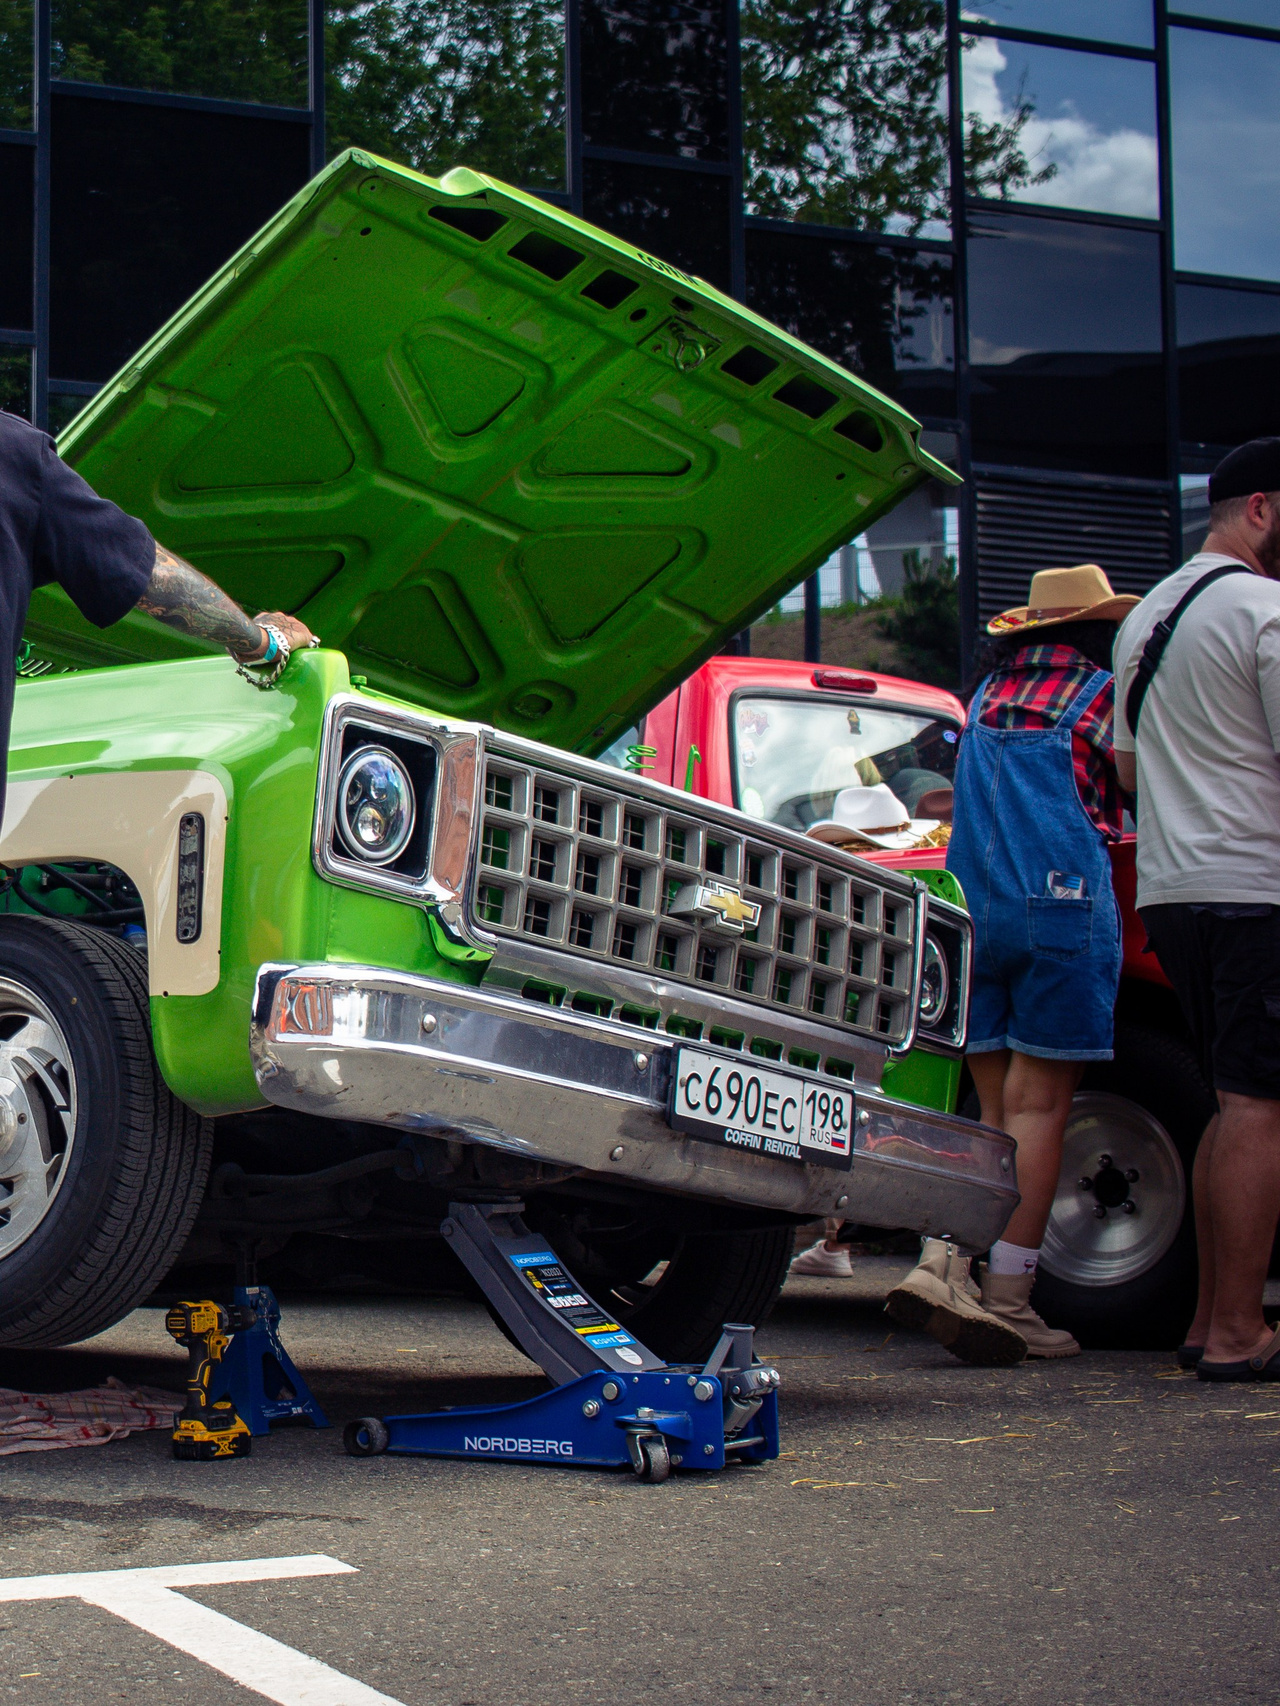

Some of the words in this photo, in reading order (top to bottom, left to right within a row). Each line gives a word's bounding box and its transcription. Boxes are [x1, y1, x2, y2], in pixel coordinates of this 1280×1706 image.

[805, 1089, 844, 1132] 198
[724, 1128, 763, 1151] COFFIN
[763, 1138, 802, 1159] RENTAL
[809, 1128, 831, 1145] RUS
[515, 1255, 553, 1265] NORDBERG
[464, 1436, 574, 1456] NORDBERG
